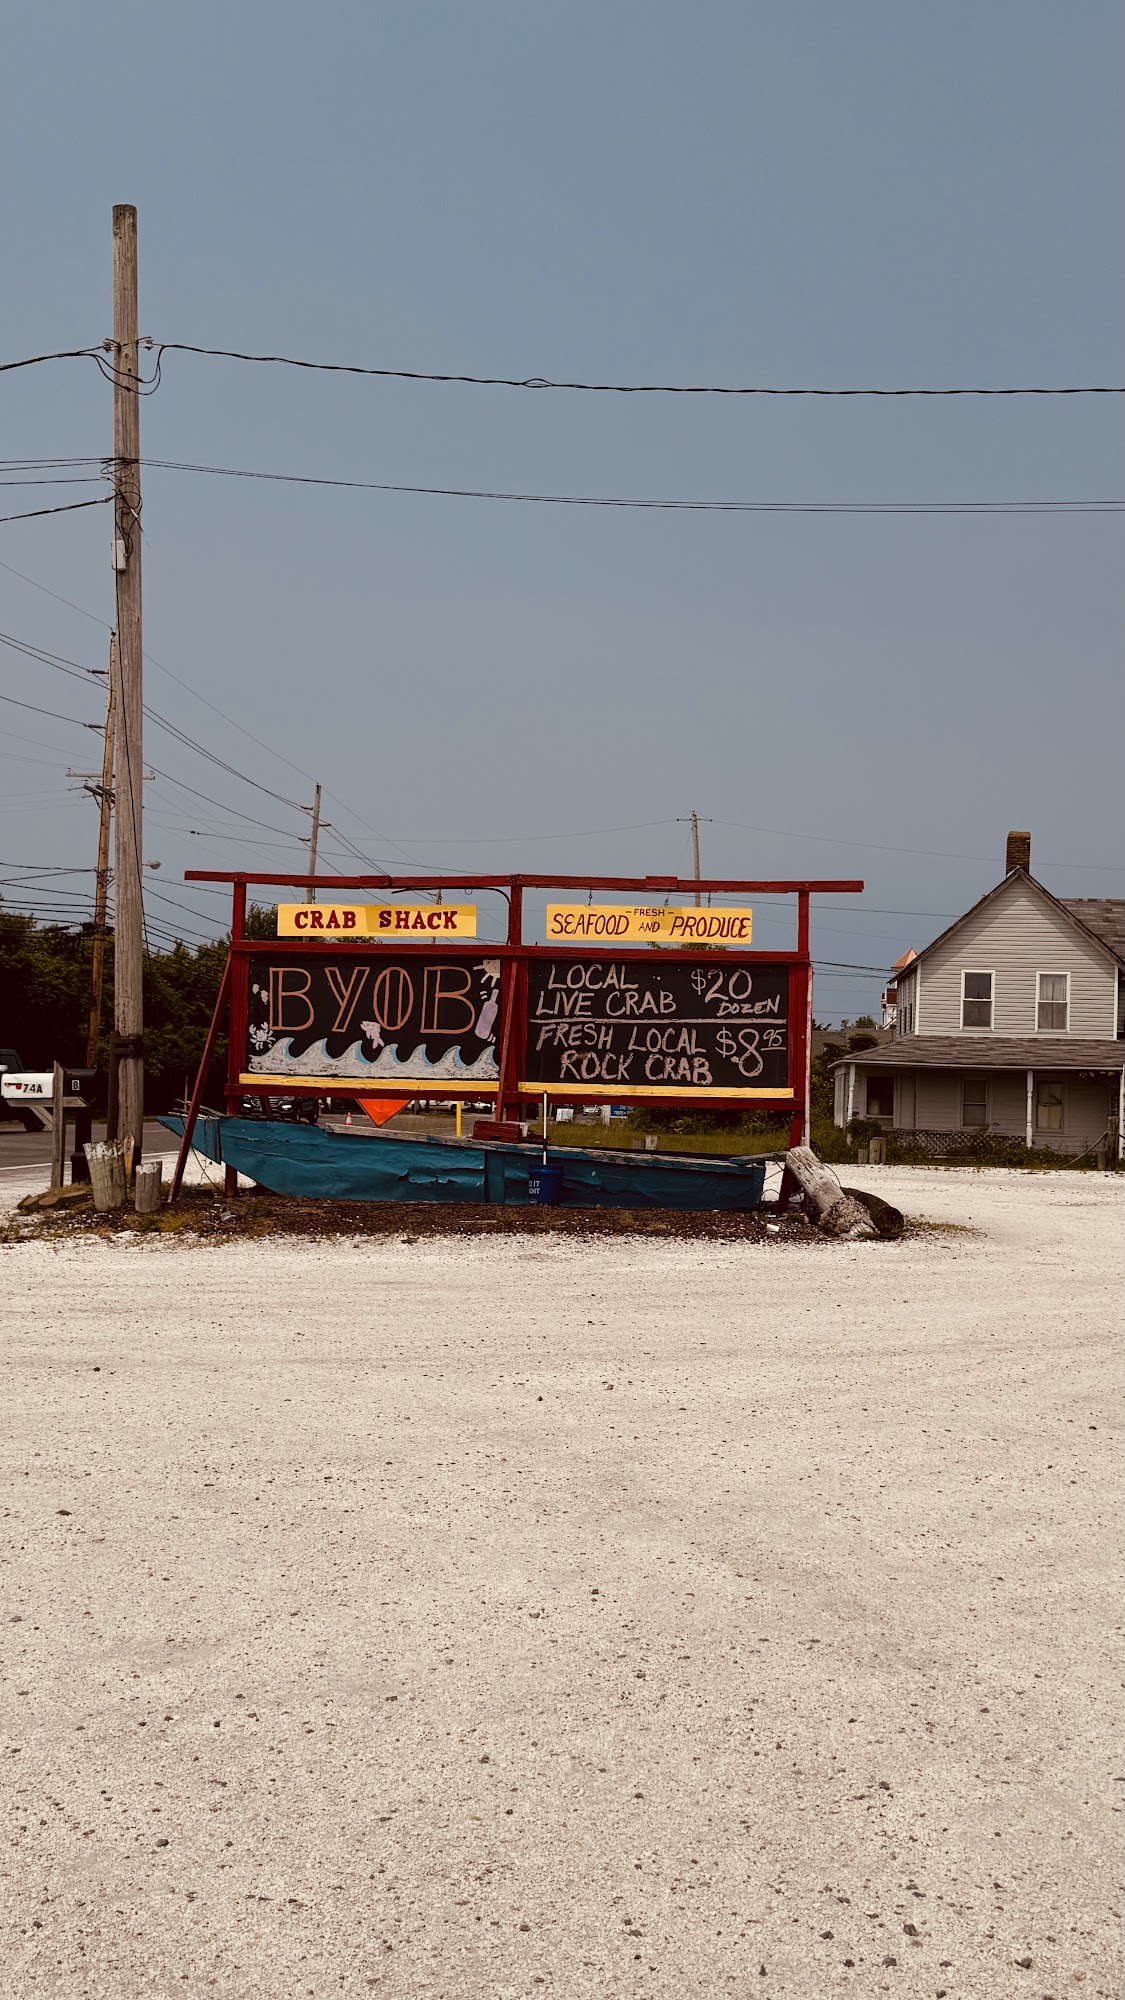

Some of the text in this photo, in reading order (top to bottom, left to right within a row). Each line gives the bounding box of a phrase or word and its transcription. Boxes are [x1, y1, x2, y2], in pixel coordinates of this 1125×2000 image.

[294, 909, 458, 930] CRAB SHACK
[633, 908, 665, 917] FRESH
[550, 913, 751, 939] SEAFOOD AND PRODUCE
[547, 963, 639, 990] LOCAL
[691, 968, 753, 1003] $20
[269, 966, 476, 1034] BYOB
[535, 990, 677, 1017] LIVE CRAB
[716, 994, 781, 1017] DOZEN
[535, 1023, 707, 1055] FRESH LOCAL
[559, 1050, 713, 1086] ROCK CRAB
[22, 1083, 43, 1094] 74A
[73, 1081, 79, 1090] B
